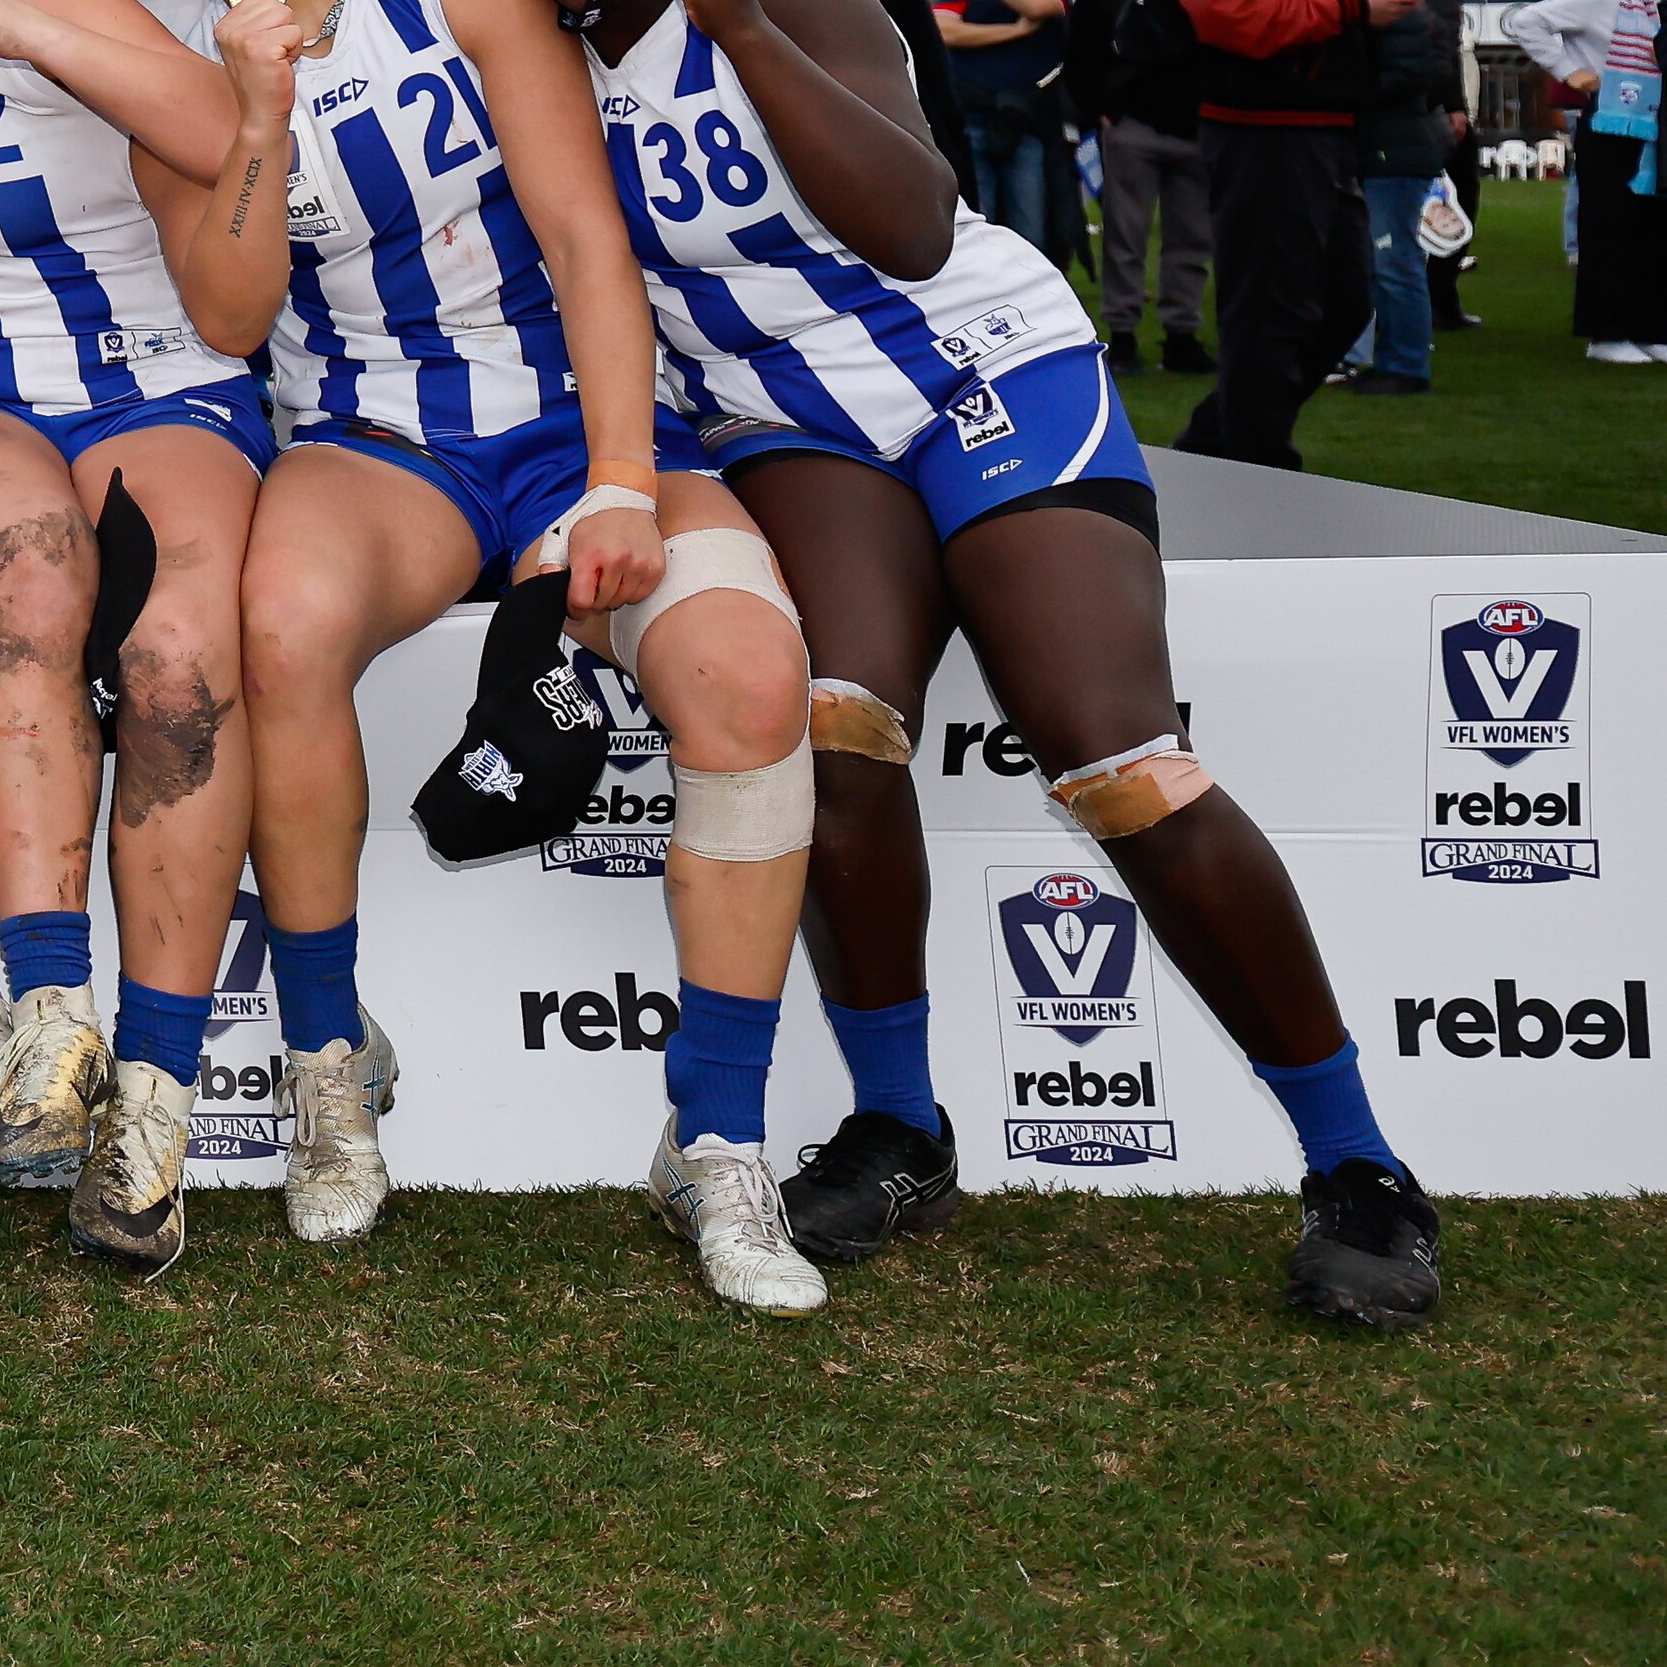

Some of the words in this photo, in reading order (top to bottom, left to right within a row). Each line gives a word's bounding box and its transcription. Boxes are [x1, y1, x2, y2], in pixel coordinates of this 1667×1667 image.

[312, 81, 353, 118] ISC
[398, 56, 498, 180] 21
[643, 109, 770, 223] 38
[966, 421, 1010, 448] rebel
[982, 462, 1009, 481] ISC
[1484, 608, 1540, 627] AFL
[607, 735, 672, 752] WOMEN
[1447, 725, 1478, 743] VFL
[1482, 724, 1570, 744] WOMEN'S
[1435, 782, 1581, 826] rebel
[547, 837, 624, 862] GRAND
[626, 837, 670, 856] FINA
[1428, 843, 1507, 870] GRAND
[1511, 842, 1594, 870] FINAL
[604, 859, 647, 874] 2024
[1488, 864, 1533, 880] 2024
[1039, 881, 1095, 902] AFL
[520, 972, 680, 1051] reb
[1017, 1003, 1049, 1021] VFL
[1052, 1003, 1137, 1022] WOMEN'S
[1394, 979, 1651, 1059] rebel
[1013, 1061, 1155, 1107] rebel
[197, 1140, 242, 1155] 2024
[1012, 1124, 1087, 1151] GRAND
[1091, 1123, 1169, 1151] FINAL
[1069, 1146, 1114, 1162] 2024
